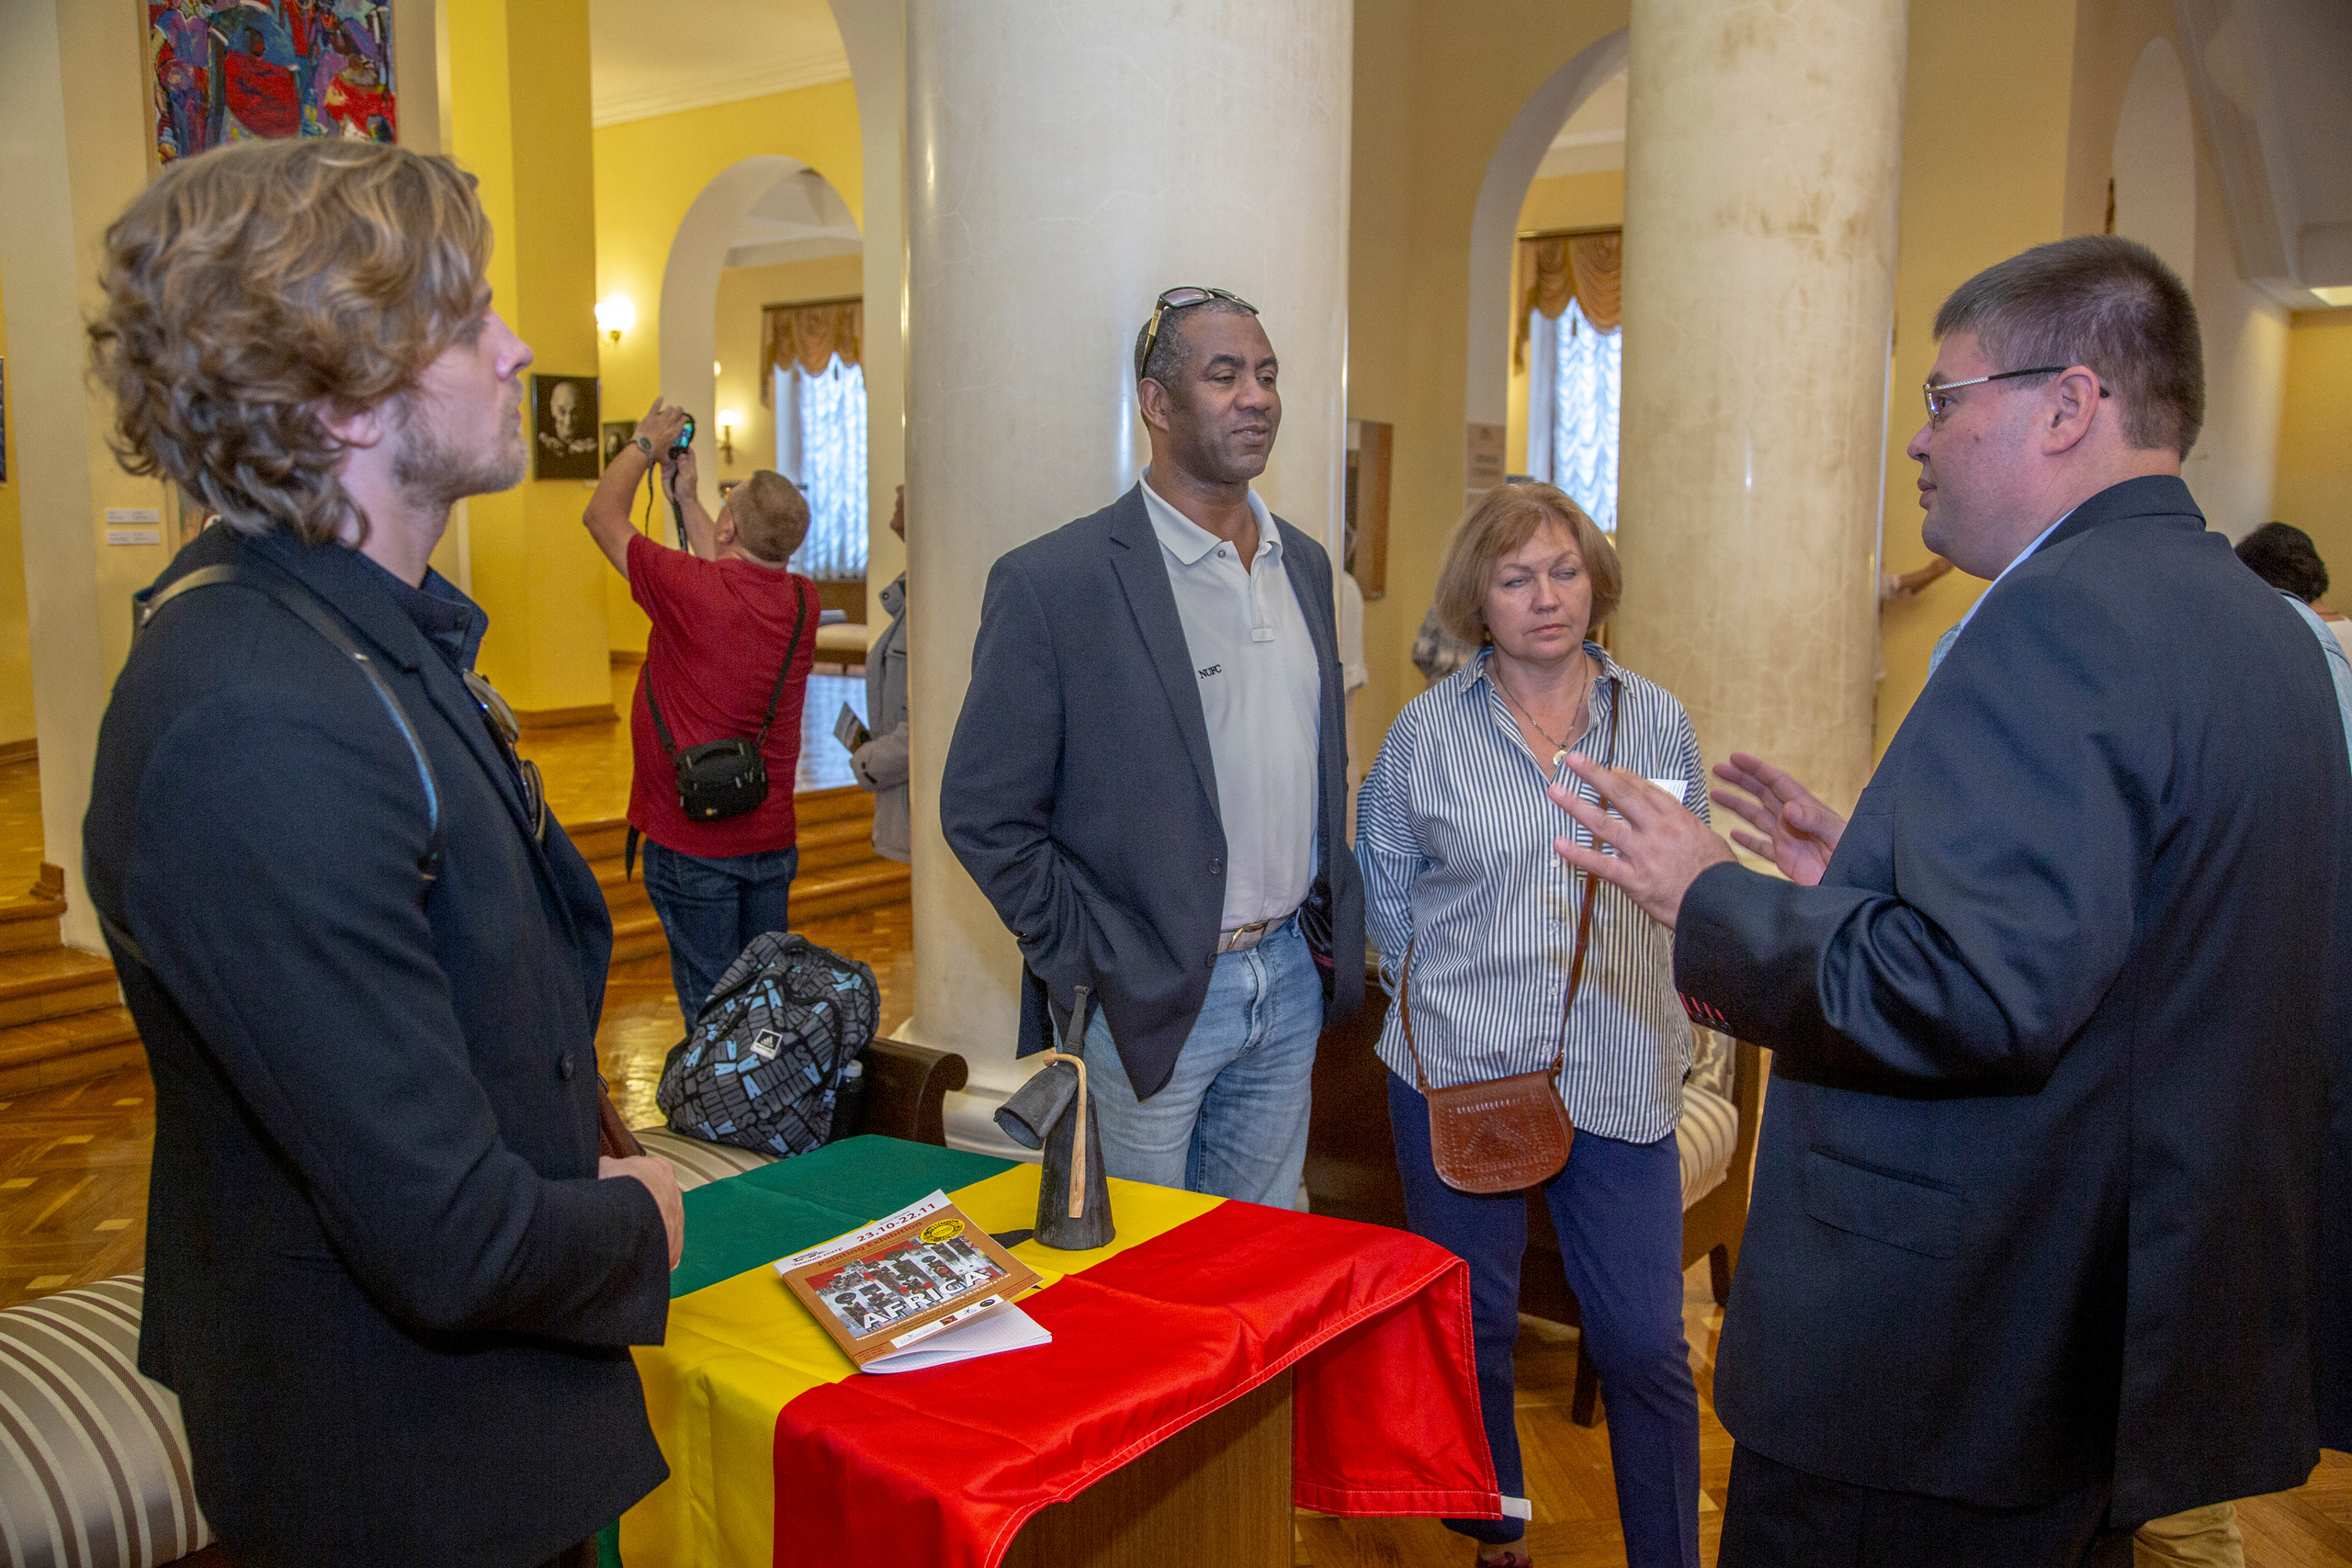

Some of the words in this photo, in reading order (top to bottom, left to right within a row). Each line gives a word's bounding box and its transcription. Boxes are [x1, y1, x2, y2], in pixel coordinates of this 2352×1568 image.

[1198, 664, 1222, 679] NUFC
[742, 1044, 812, 1100] ADIDAS
[818, 1246, 865, 1267] Painting
[865, 1221, 922, 1247] Exhibition
[856, 1202, 936, 1243] 23.10-22.11
[863, 1270, 989, 1329] AFRICA
[926, 1303, 943, 1314] Grand
[943, 1294, 965, 1307] opening
